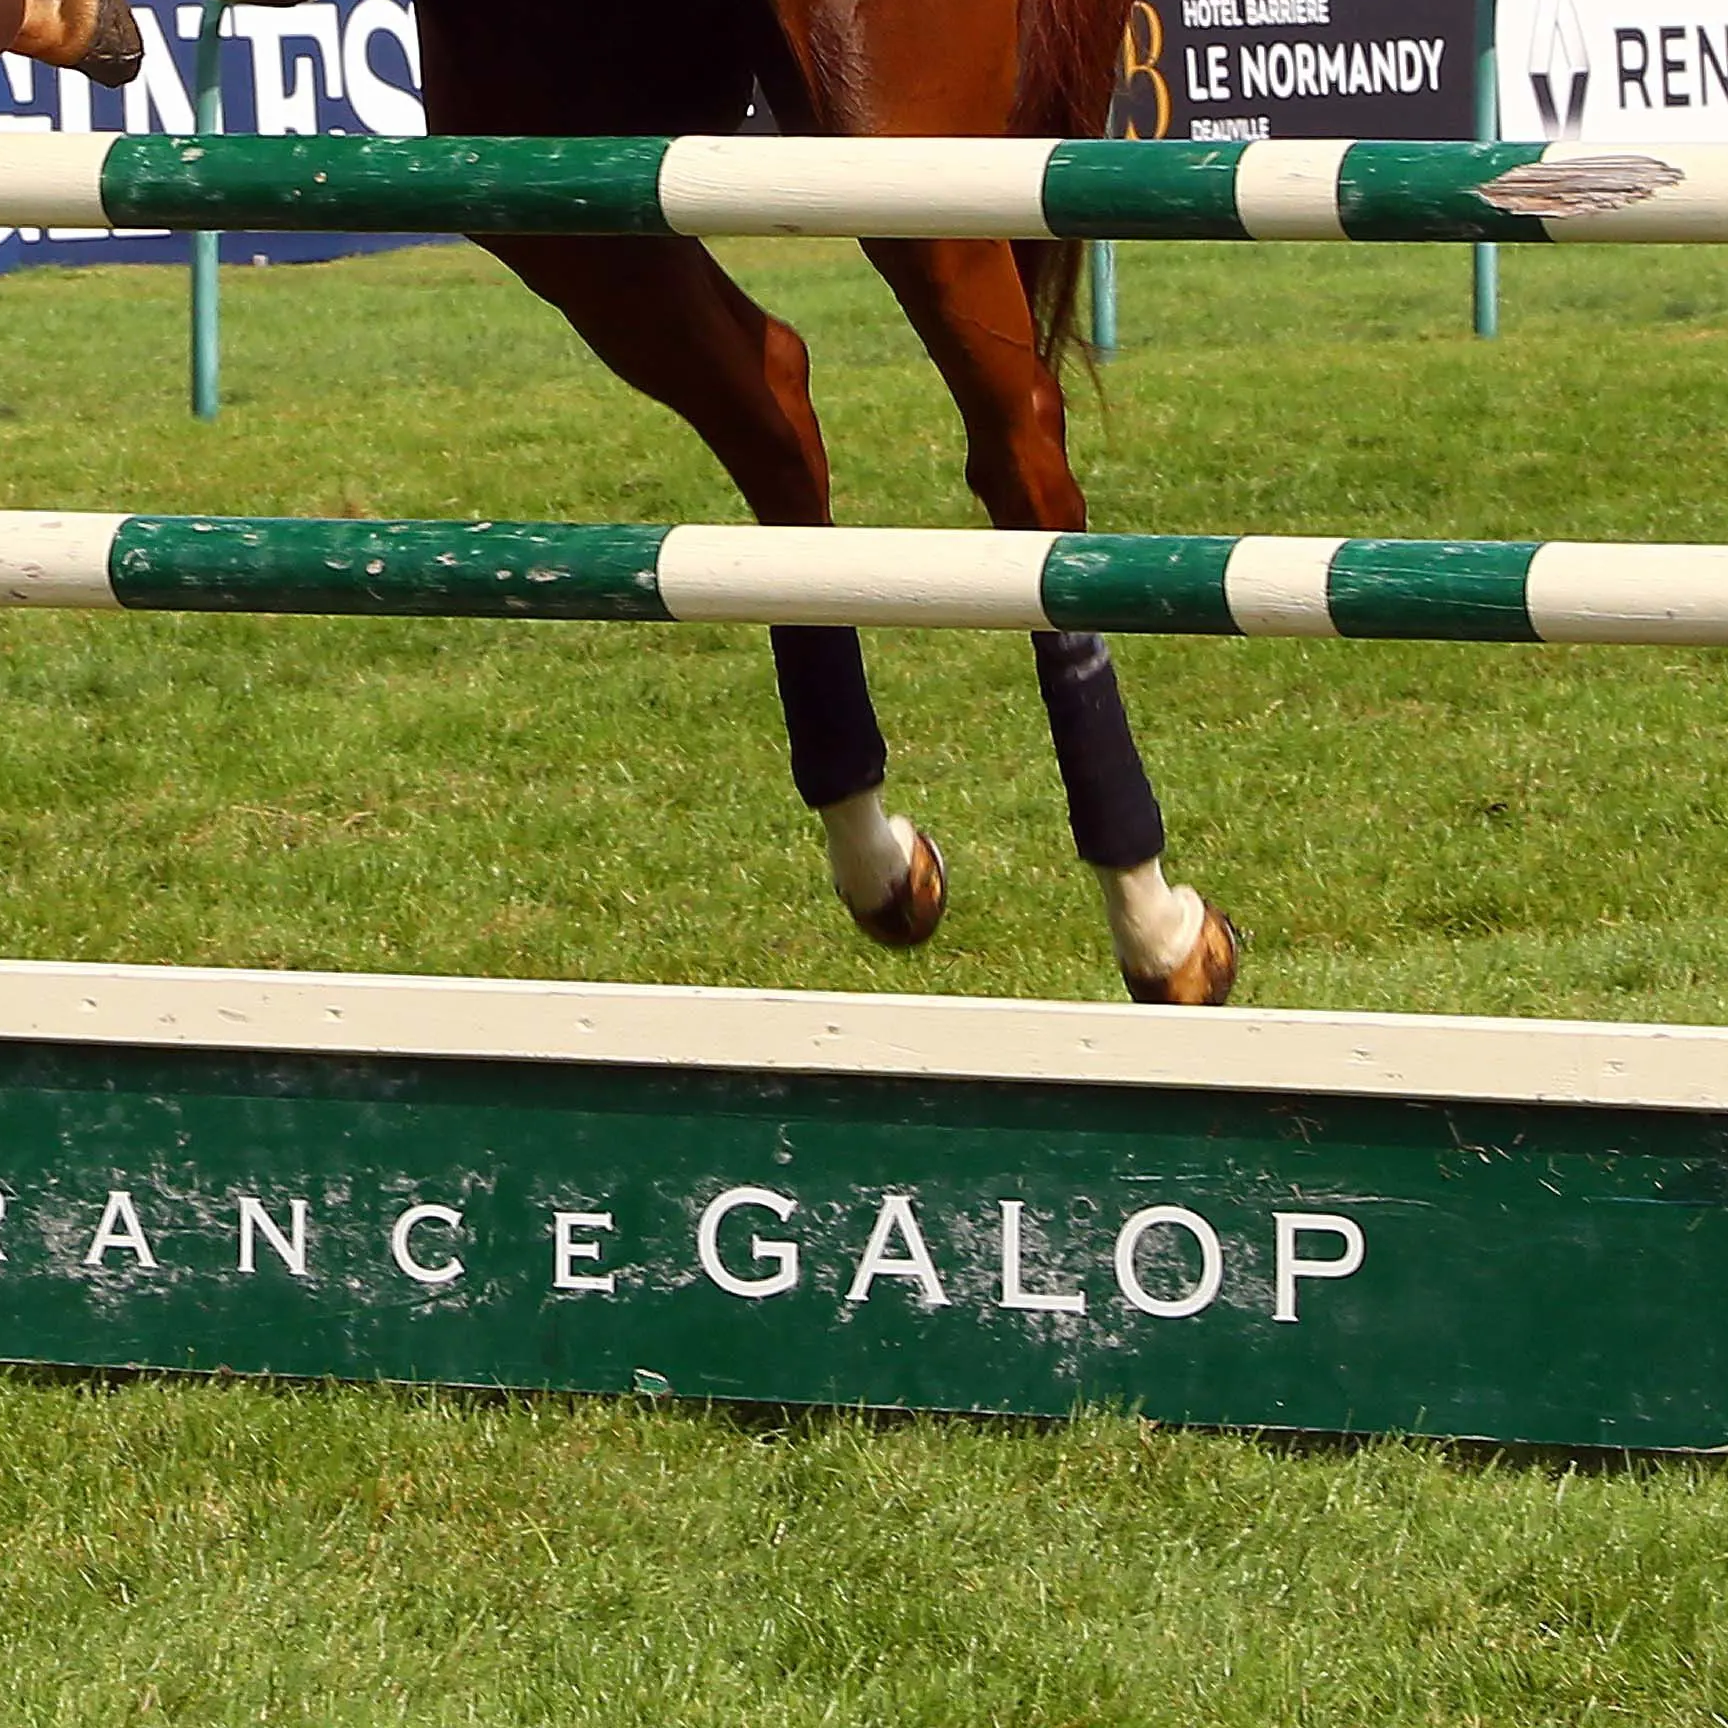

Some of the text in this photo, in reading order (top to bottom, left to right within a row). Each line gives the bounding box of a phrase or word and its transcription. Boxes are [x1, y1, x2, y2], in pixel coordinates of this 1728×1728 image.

[1184, 37, 1446, 102] LE NORMANDY
[694, 1185, 1368, 1323] GALOP
